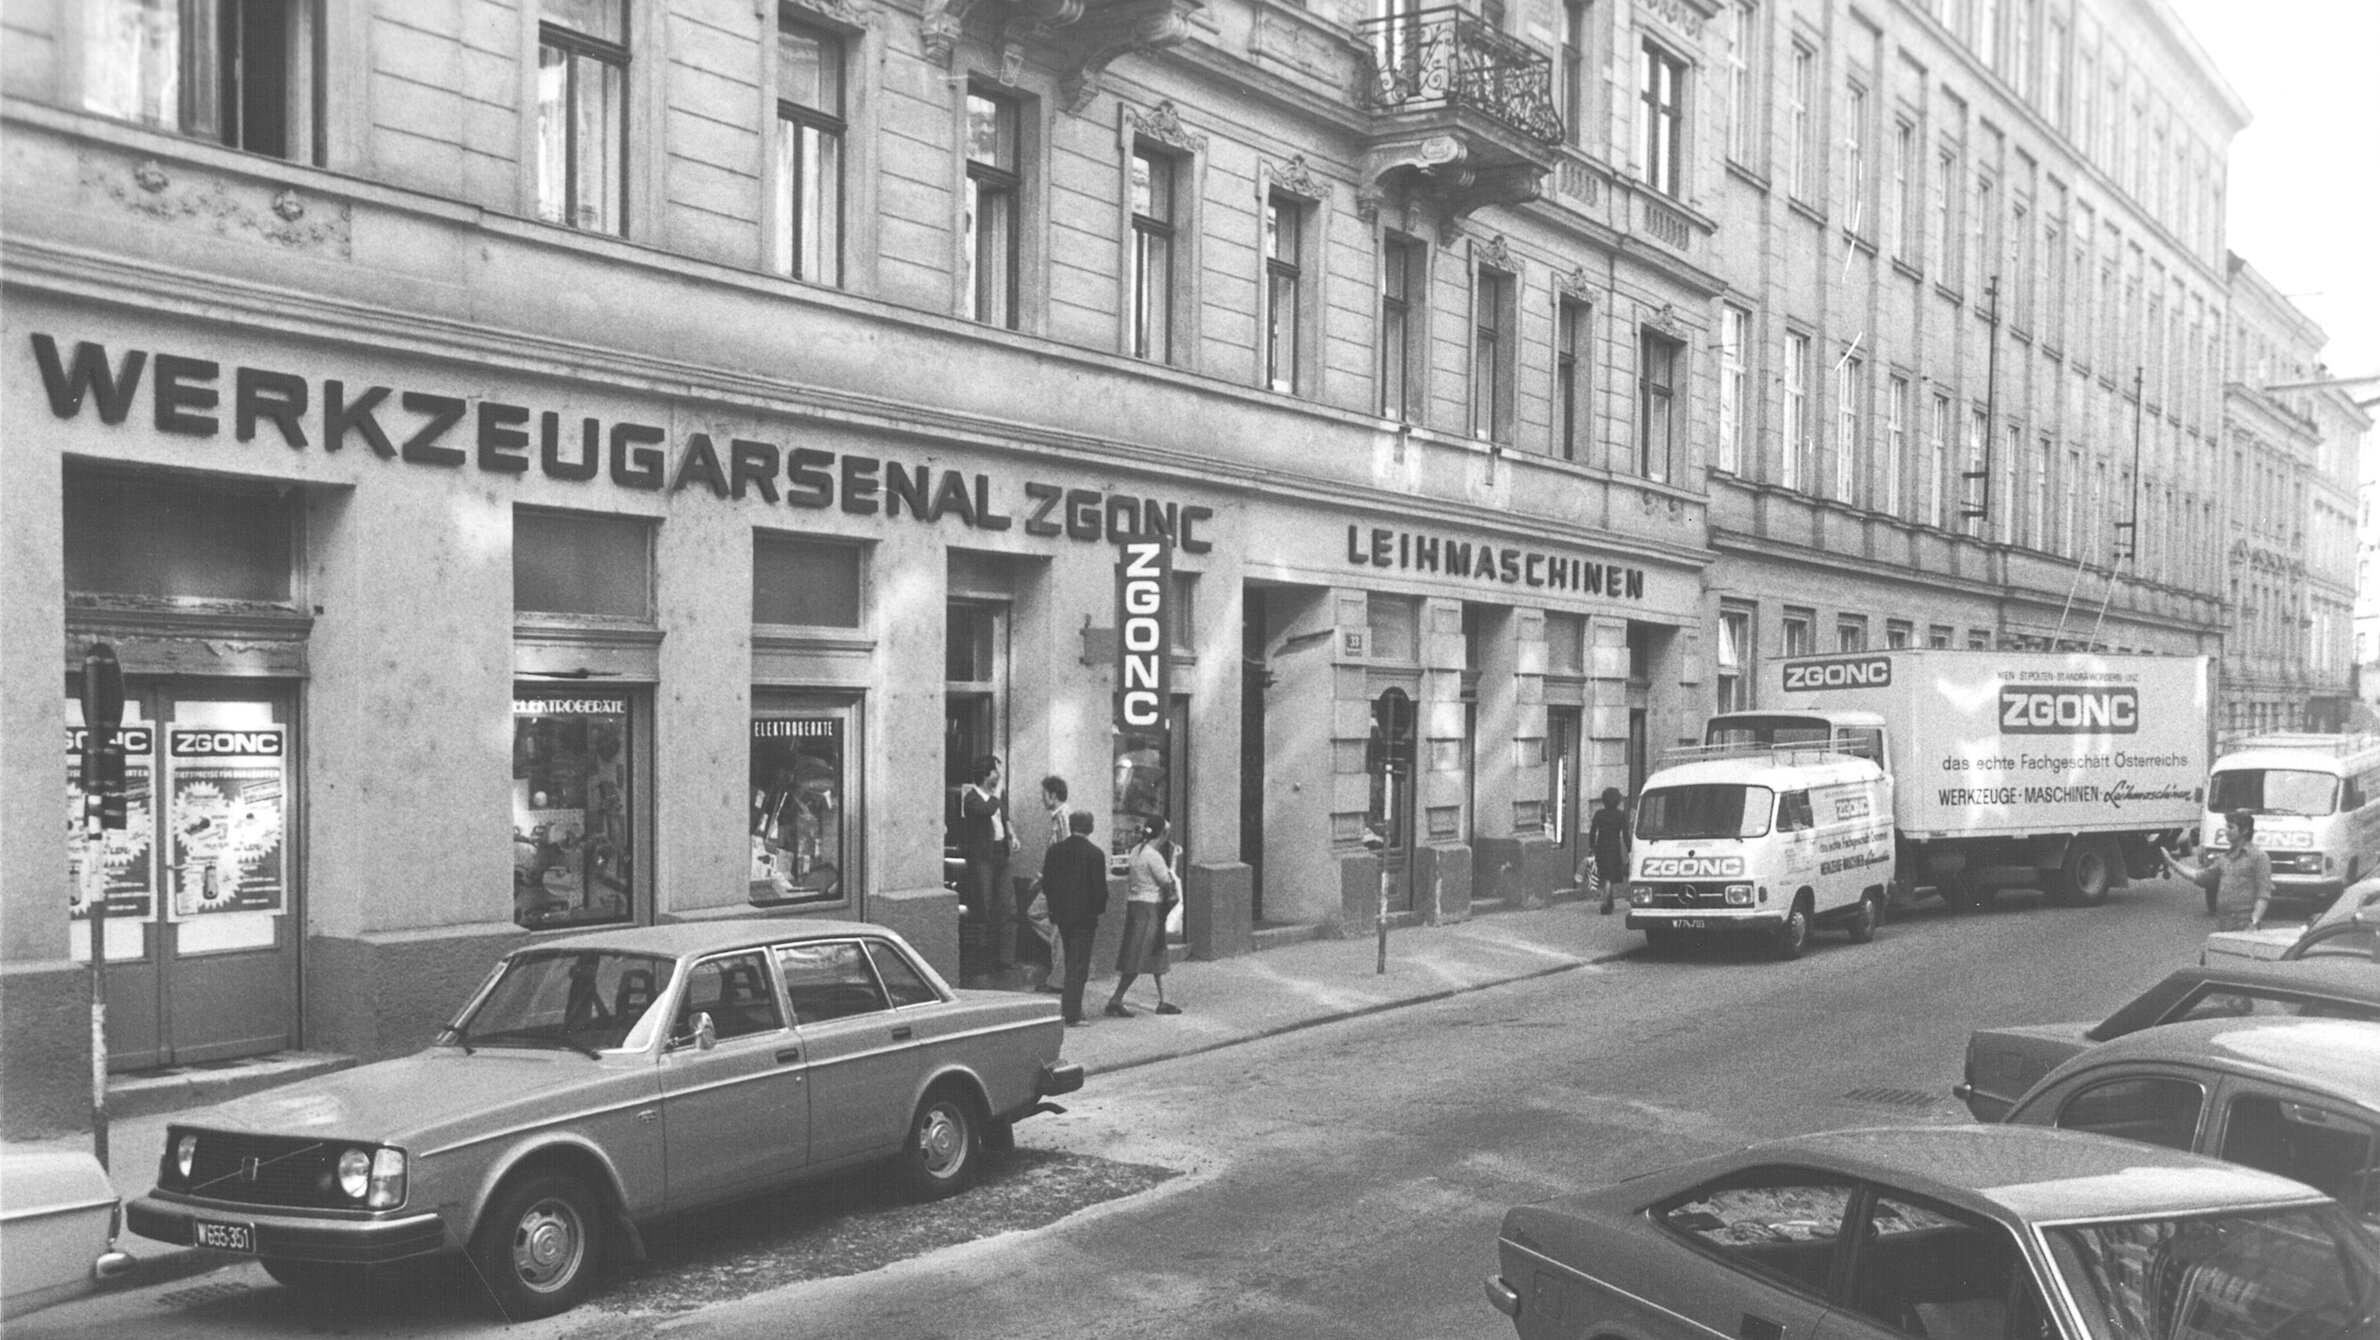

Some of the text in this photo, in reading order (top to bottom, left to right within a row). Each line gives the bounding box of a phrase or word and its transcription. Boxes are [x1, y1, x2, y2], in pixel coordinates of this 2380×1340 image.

[31, 332, 1213, 553] WERKZEUGARSENAL ZGONC
[1348, 525, 1644, 600] LEIHMASCHINEN
[1124, 543, 1161, 727] ZGONC
[1786, 661, 1888, 688] ZGONC
[512, 698, 625, 714] ELEKTROGERÄTE
[2002, 693, 2136, 727] ZGONC
[176, 733, 279, 754] ZGONC
[1942, 750, 2189, 774] das echte Fachgeschäft Österreichs
[1938, 787, 2018, 806] WERKZEUGE
[2024, 785, 2099, 804] MASCHINEN
[1643, 859, 1743, 877] ZGONC
